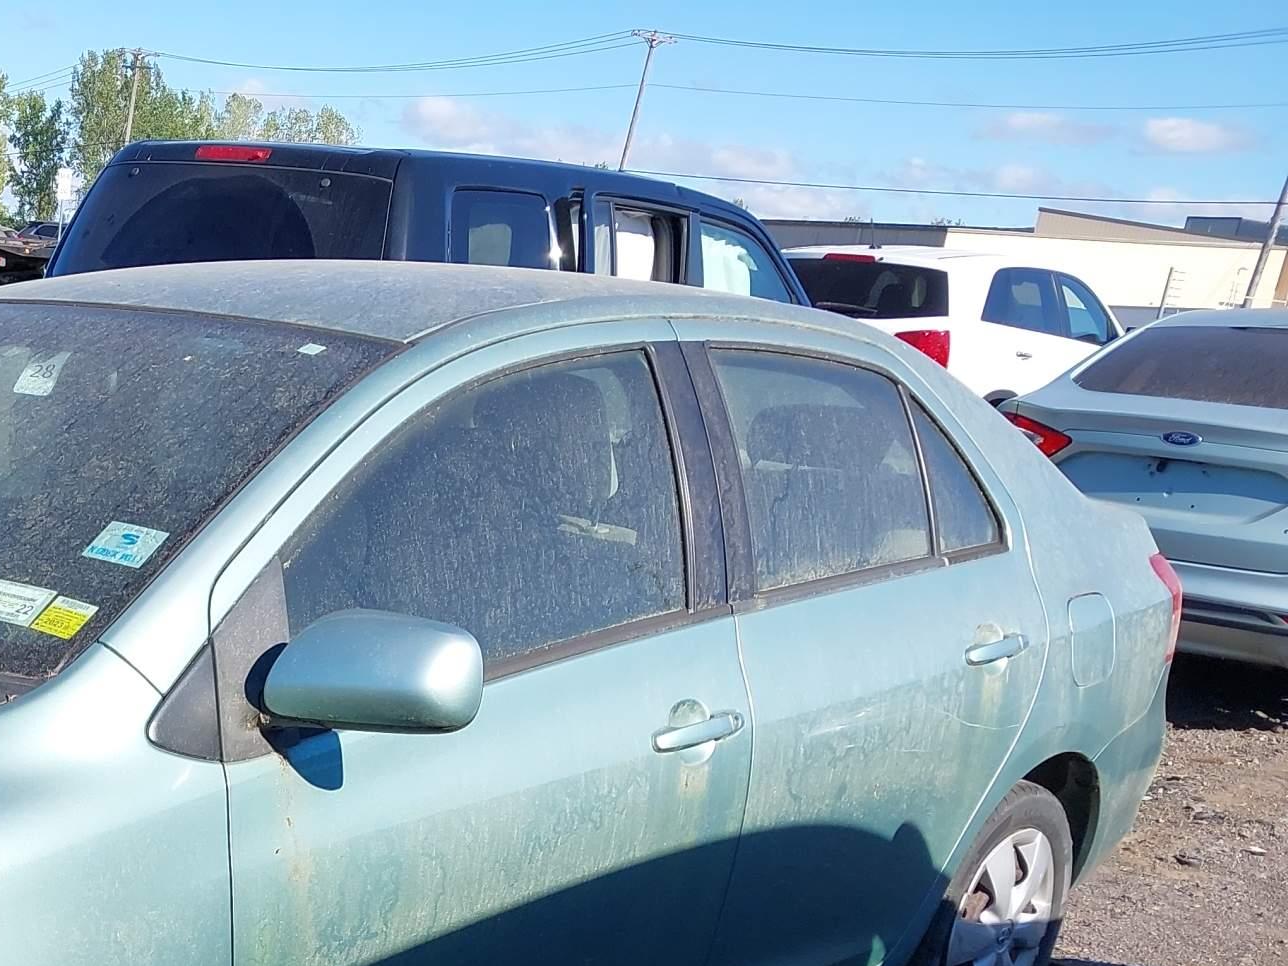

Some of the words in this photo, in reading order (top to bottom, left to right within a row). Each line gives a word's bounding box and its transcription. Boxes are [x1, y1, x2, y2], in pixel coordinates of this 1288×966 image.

[29, 364, 56, 379] 28
[15, 603, 35, 616] 22
[44, 617, 65, 629] 2023
